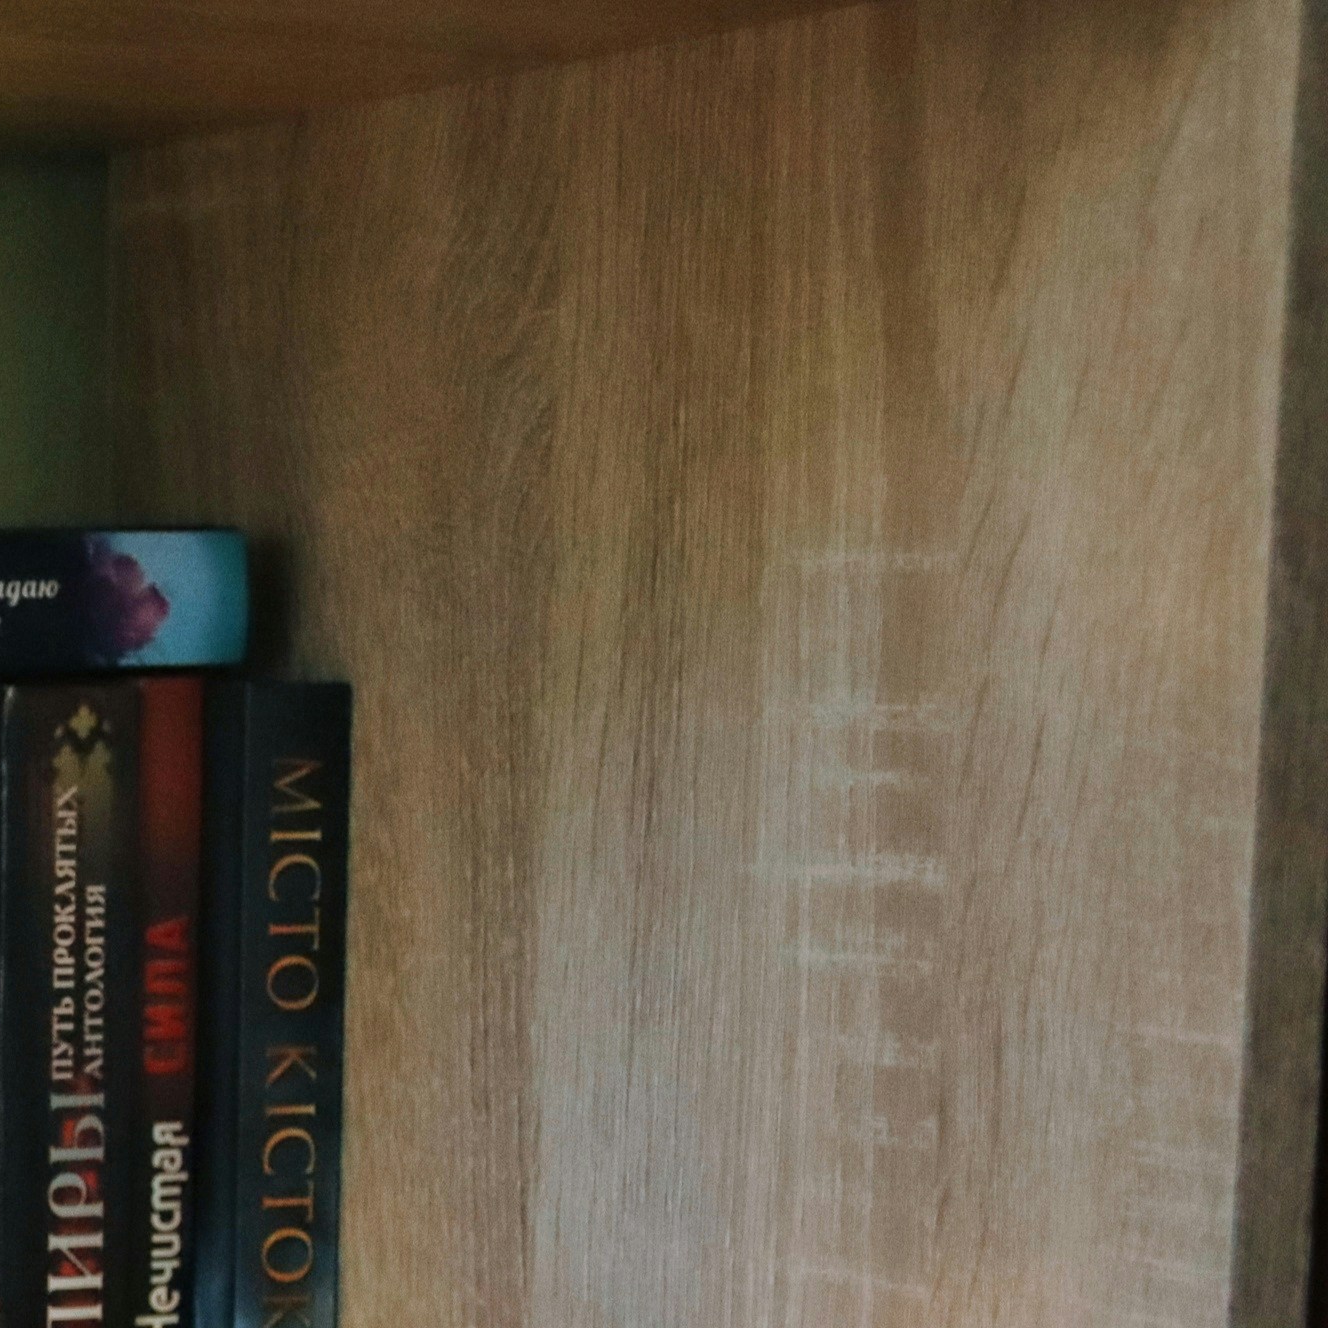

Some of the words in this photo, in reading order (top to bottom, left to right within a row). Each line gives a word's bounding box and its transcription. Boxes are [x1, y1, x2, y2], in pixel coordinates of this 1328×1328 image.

[51, 784, 79, 989] ПРОКЛЯТЫХ
[83, 883, 106, 1081] АНТОЛОГИЯ
[265, 757, 324, 1012] МІСТО
[49, 996, 76, 1081] ПУТЬ
[143, 916, 189, 1076] СИЛА
